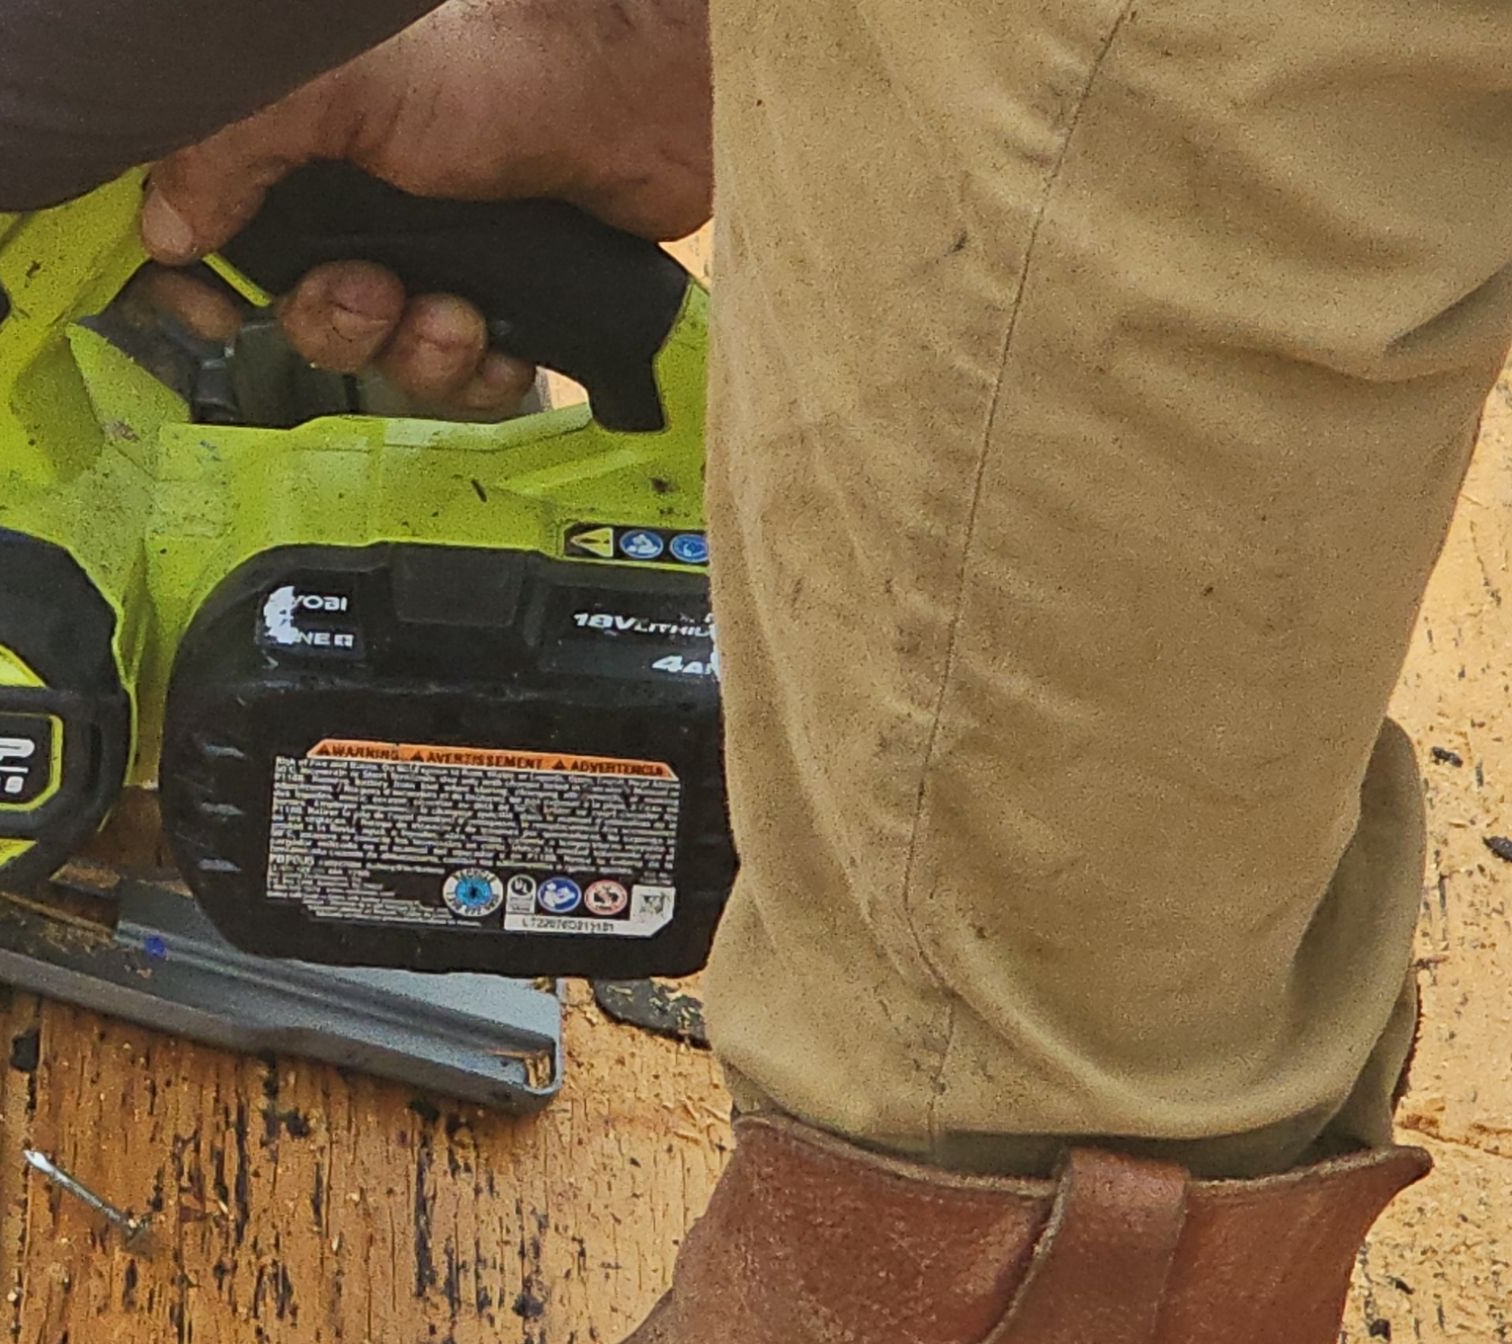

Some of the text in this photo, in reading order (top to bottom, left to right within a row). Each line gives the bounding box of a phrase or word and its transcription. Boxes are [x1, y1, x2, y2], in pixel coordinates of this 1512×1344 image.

[573, 612, 713, 638] 18V LITHIU
[331, 745, 400, 759] WARNING
[427, 751, 543, 768] AVERTISSEMENT
